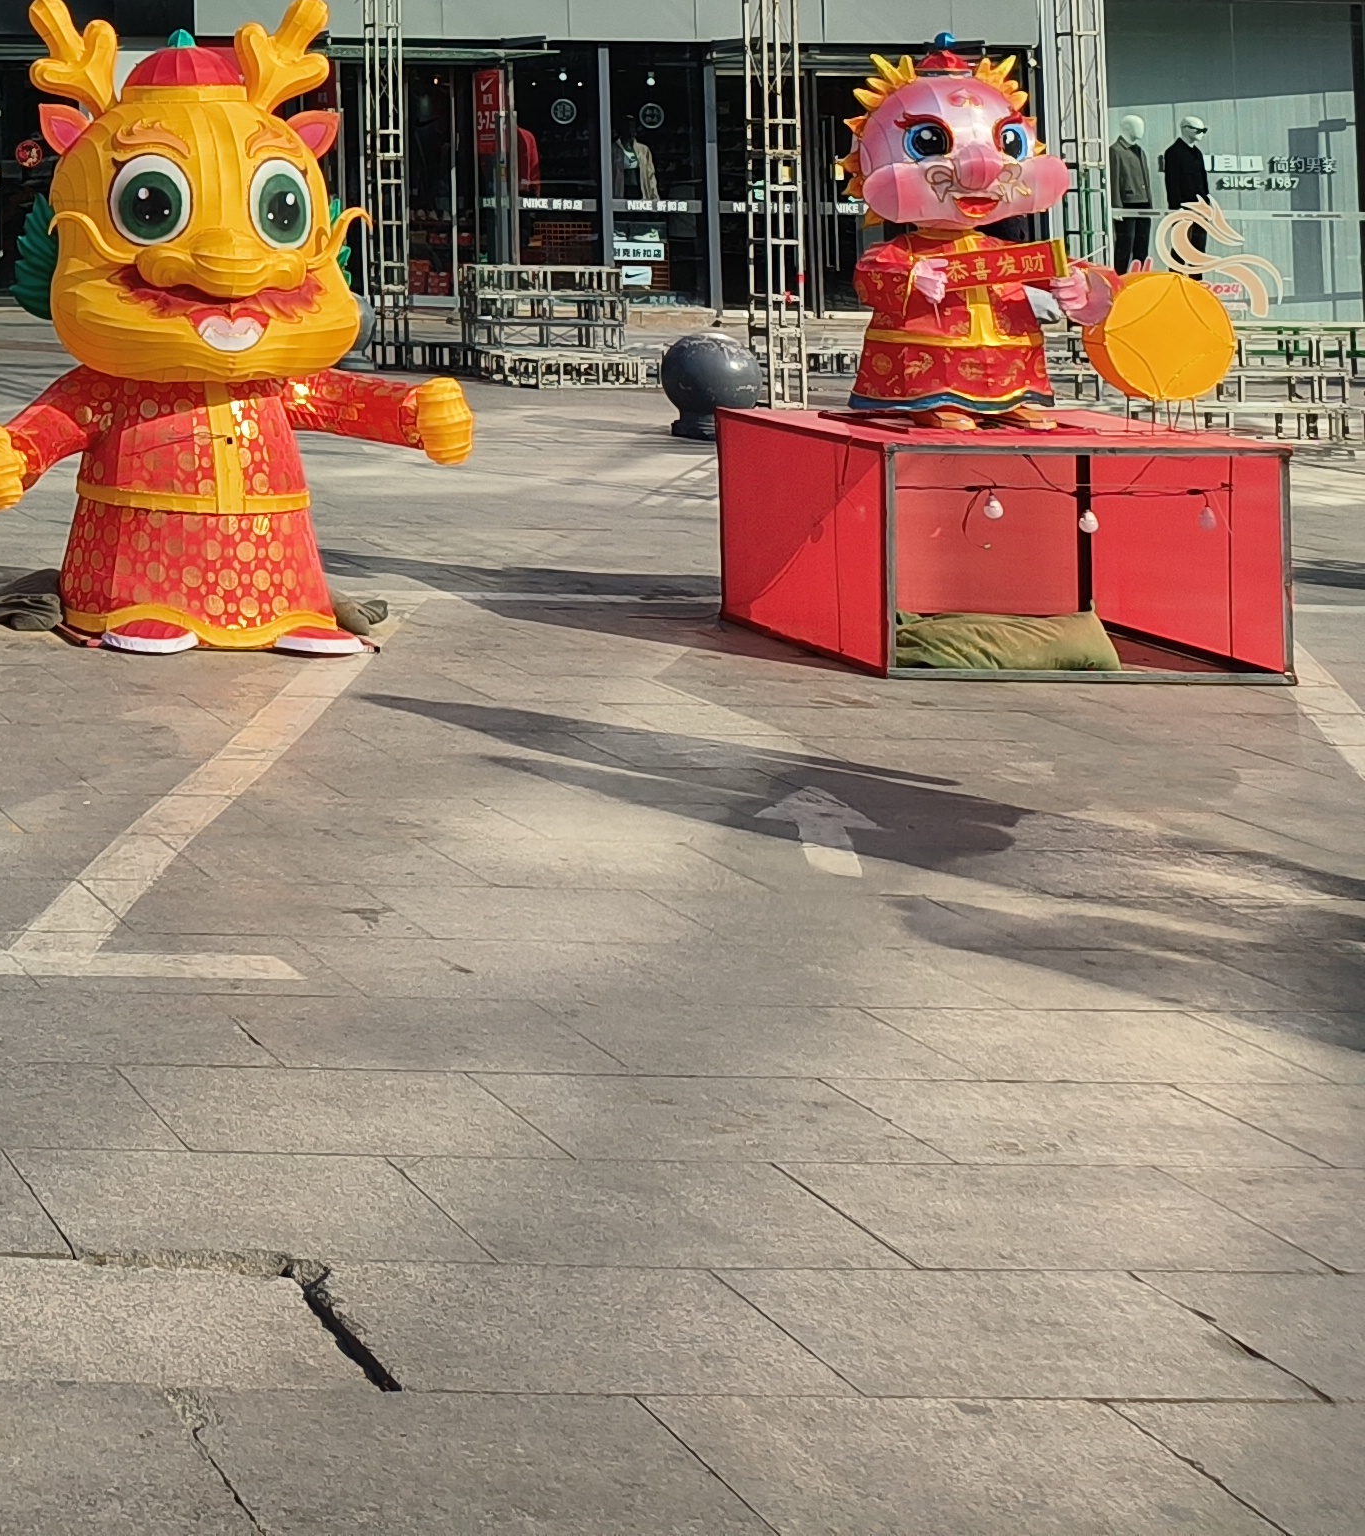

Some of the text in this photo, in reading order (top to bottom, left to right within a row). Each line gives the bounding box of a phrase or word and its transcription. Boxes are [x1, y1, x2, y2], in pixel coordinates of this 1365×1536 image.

[1272, 156, 1336, 173] 简约男装
[522, 198, 549, 209] NIKE
[627, 200, 653, 211] NIKE
[732, 202, 759, 212] NIE
[946, 252, 1046, 283] 恭喜发财
